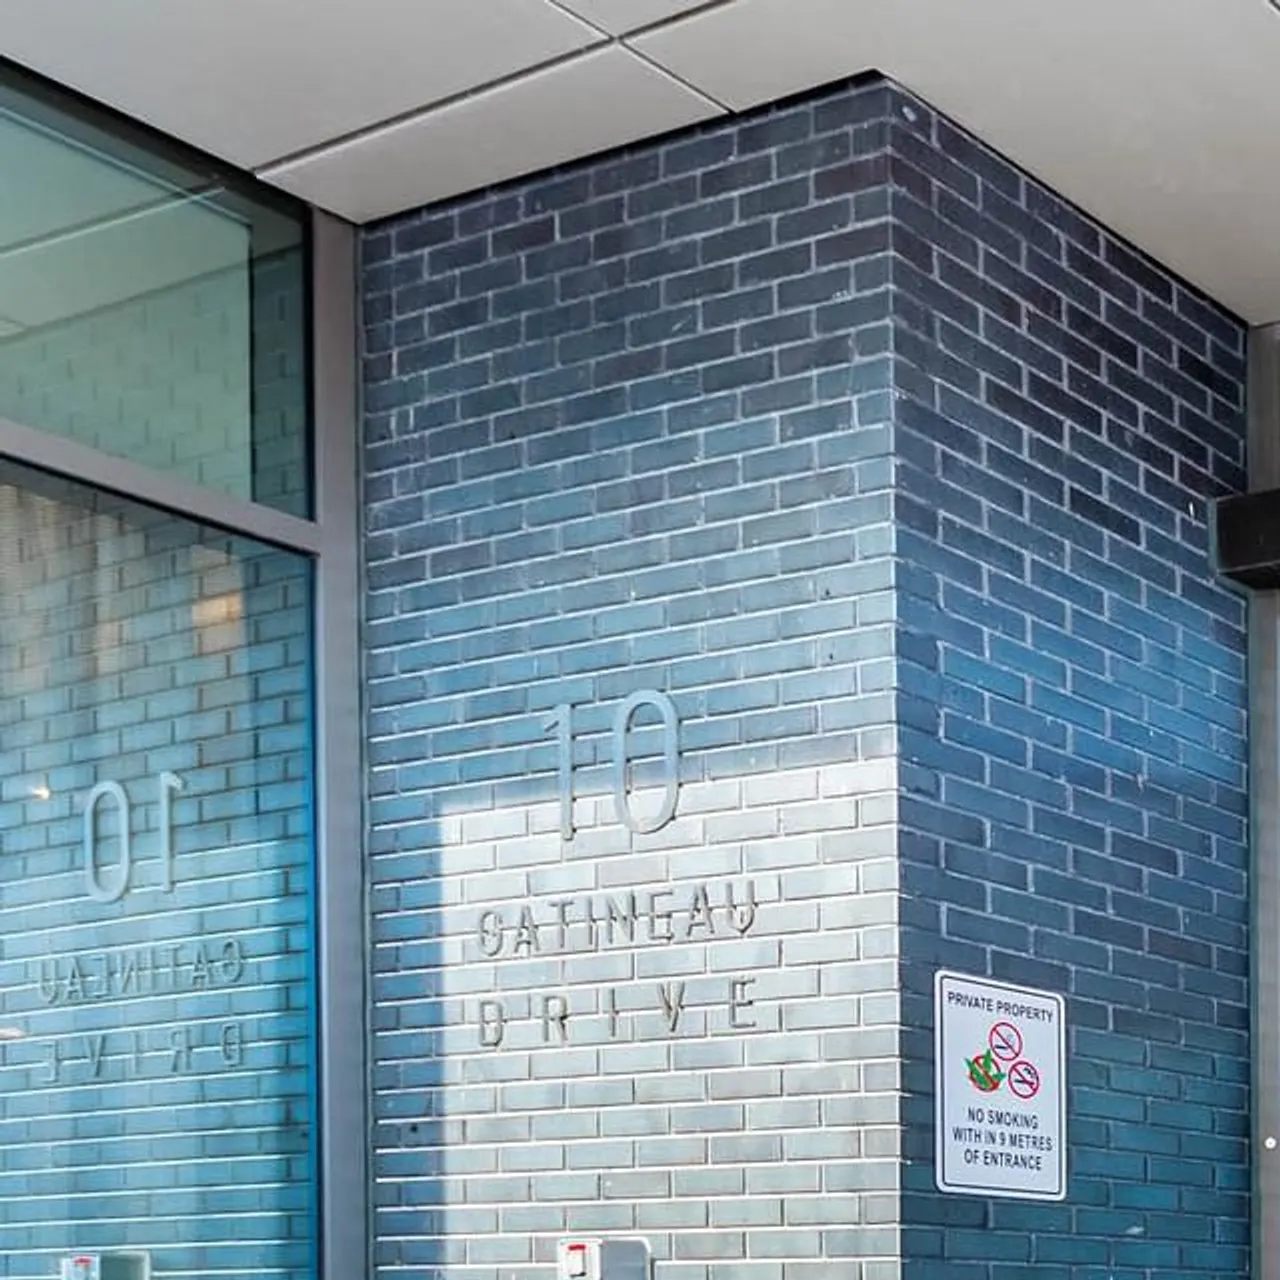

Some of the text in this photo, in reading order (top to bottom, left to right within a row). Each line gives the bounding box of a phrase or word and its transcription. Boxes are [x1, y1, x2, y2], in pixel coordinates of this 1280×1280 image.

[544, 688, 680, 841] 10
[478, 879, 758, 957] GATINEAU
[478, 976, 757, 1048] DRIVE
[947, 991, 1054, 1023] PRIVATE PROPERTY
[968, 1107, 1039, 1130] NO SMOKING
[952, 1126, 1054, 1152] WITH IN 9 METRES
[963, 1148, 1043, 1171] OF ENTRANCE
